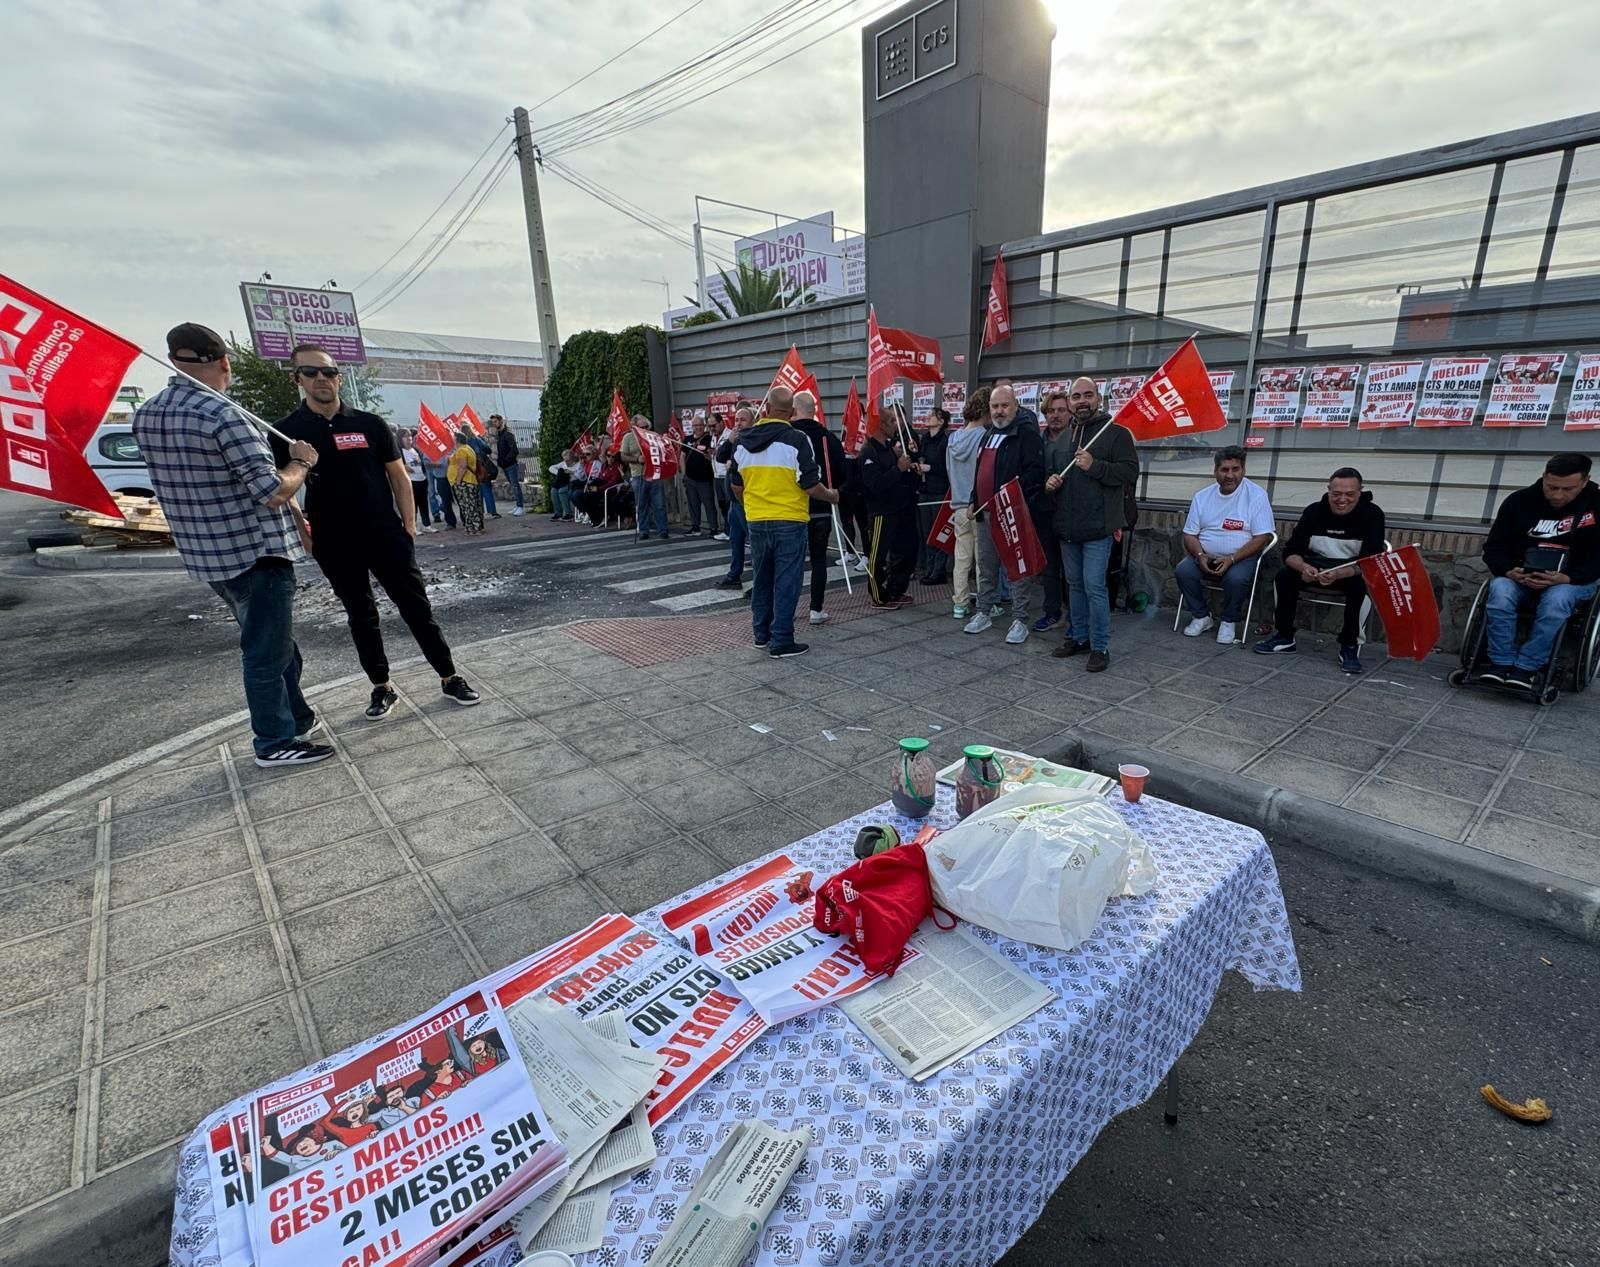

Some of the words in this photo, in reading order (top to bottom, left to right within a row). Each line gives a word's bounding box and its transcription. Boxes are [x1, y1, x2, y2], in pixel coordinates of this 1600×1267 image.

[921, 24, 949, 53] CTS
[768, 232, 805, 267] DECO
[778, 256, 827, 291] RDEN
[287, 291, 330, 309] DECO
[292, 307, 355, 327] GARDEN
[1368, 366, 1408, 383] HUELGA!!
[1431, 363, 1480, 380] HUELGA!!
[1368, 383, 1382, 392] CTS
[1384, 383, 1390, 391] Y
[1391, 382, 1417, 391] AMIAB
[1425, 380, 1441, 390] CTS
[1443, 380, 1456, 390] NO
[1457, 379, 1481, 390] PAGA
[1493, 385, 1505, 393] CTS
[1511, 385, 1536, 393] MALOS
[1575, 379, 1596, 389] CTS
[1366, 393, 1413, 402] RESPONSABLES
[1502, 403, 1509, 411] 2
[1509, 403, 1535, 411] MESES
[1536, 403, 1550, 411] SIN
[1315, 407, 1320, 415] 2
[1320, 407, 1339, 415] MESES
[1340, 407, 1351, 415] SIN
[335, 434, 366, 443] CCOO
[1224, 519, 1243, 528] CCOO
[1533, 519, 1560, 535] NIK
[716, 891, 780, 945] HUELGA!!
[714, 903, 815, 963] SPONSABLES
[663, 954, 692, 974] 120
[724, 936, 805, 982] AMIAB
[791, 942, 862, 1002] ELGA!!
[668, 966, 723, 1009] CTS
[574, 977, 631, 1020] cobrar
[464, 1012, 489, 1038] SECUNDA
[630, 1001, 679, 1038] NO
[397, 1007, 463, 1054] HUELGA!!
[379, 1051, 415, 1074] GORDITO
[383, 1059, 415, 1079] SUELTA
[267, 1086, 312, 1107] CCOO
[280, 1102, 319, 1123] BARBAS
[283, 1108, 321, 1129] PAGA!!!
[268, 1168, 326, 1214] CTS
[353, 1105, 449, 1173] MALOS
[736, 1136, 770, 1185] cumpleaños
[761, 1153, 770, 1164] de
[779, 1138, 804, 1169] Familia
[339, 1208, 366, 1247] 2
[373, 1143, 487, 1226] MESES
[492, 1112, 543, 1157] SIN
[752, 1164, 763, 1177] su
[429, 1138, 549, 1229] COBRA
[753, 1176, 778, 1209] amigos
